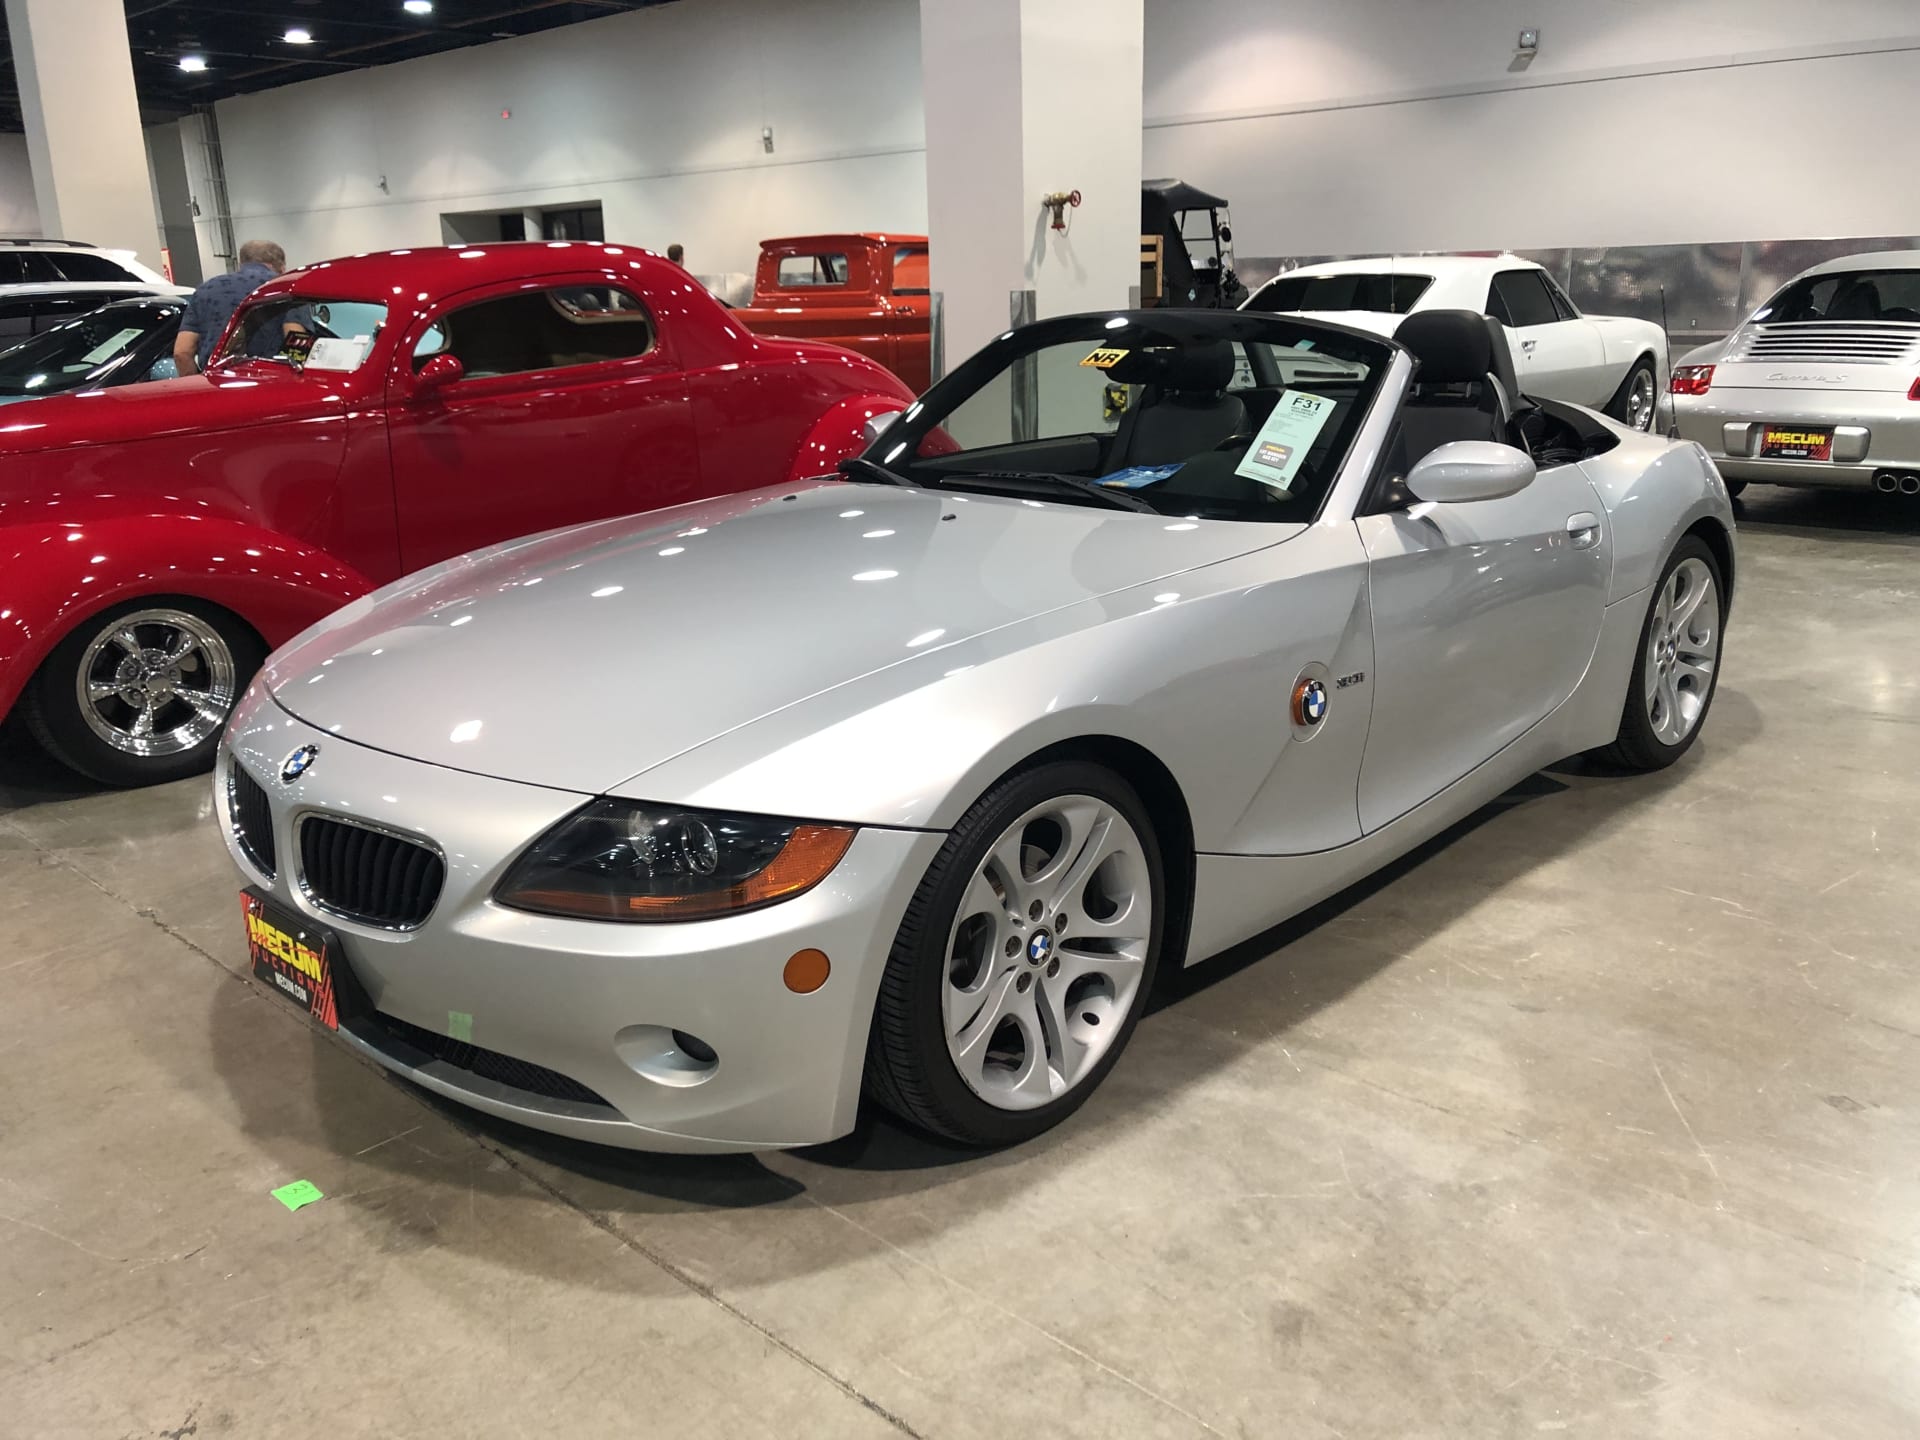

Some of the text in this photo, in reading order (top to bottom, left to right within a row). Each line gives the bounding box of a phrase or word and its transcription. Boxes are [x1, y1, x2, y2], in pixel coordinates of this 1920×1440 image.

[1086, 353, 1120, 363] NR
[1292, 398, 1322, 411] F31
[1767, 432, 1826, 445] MECUM
[248, 913, 322, 982] MECUM
[274, 971, 308, 1004] MECUM.COM
